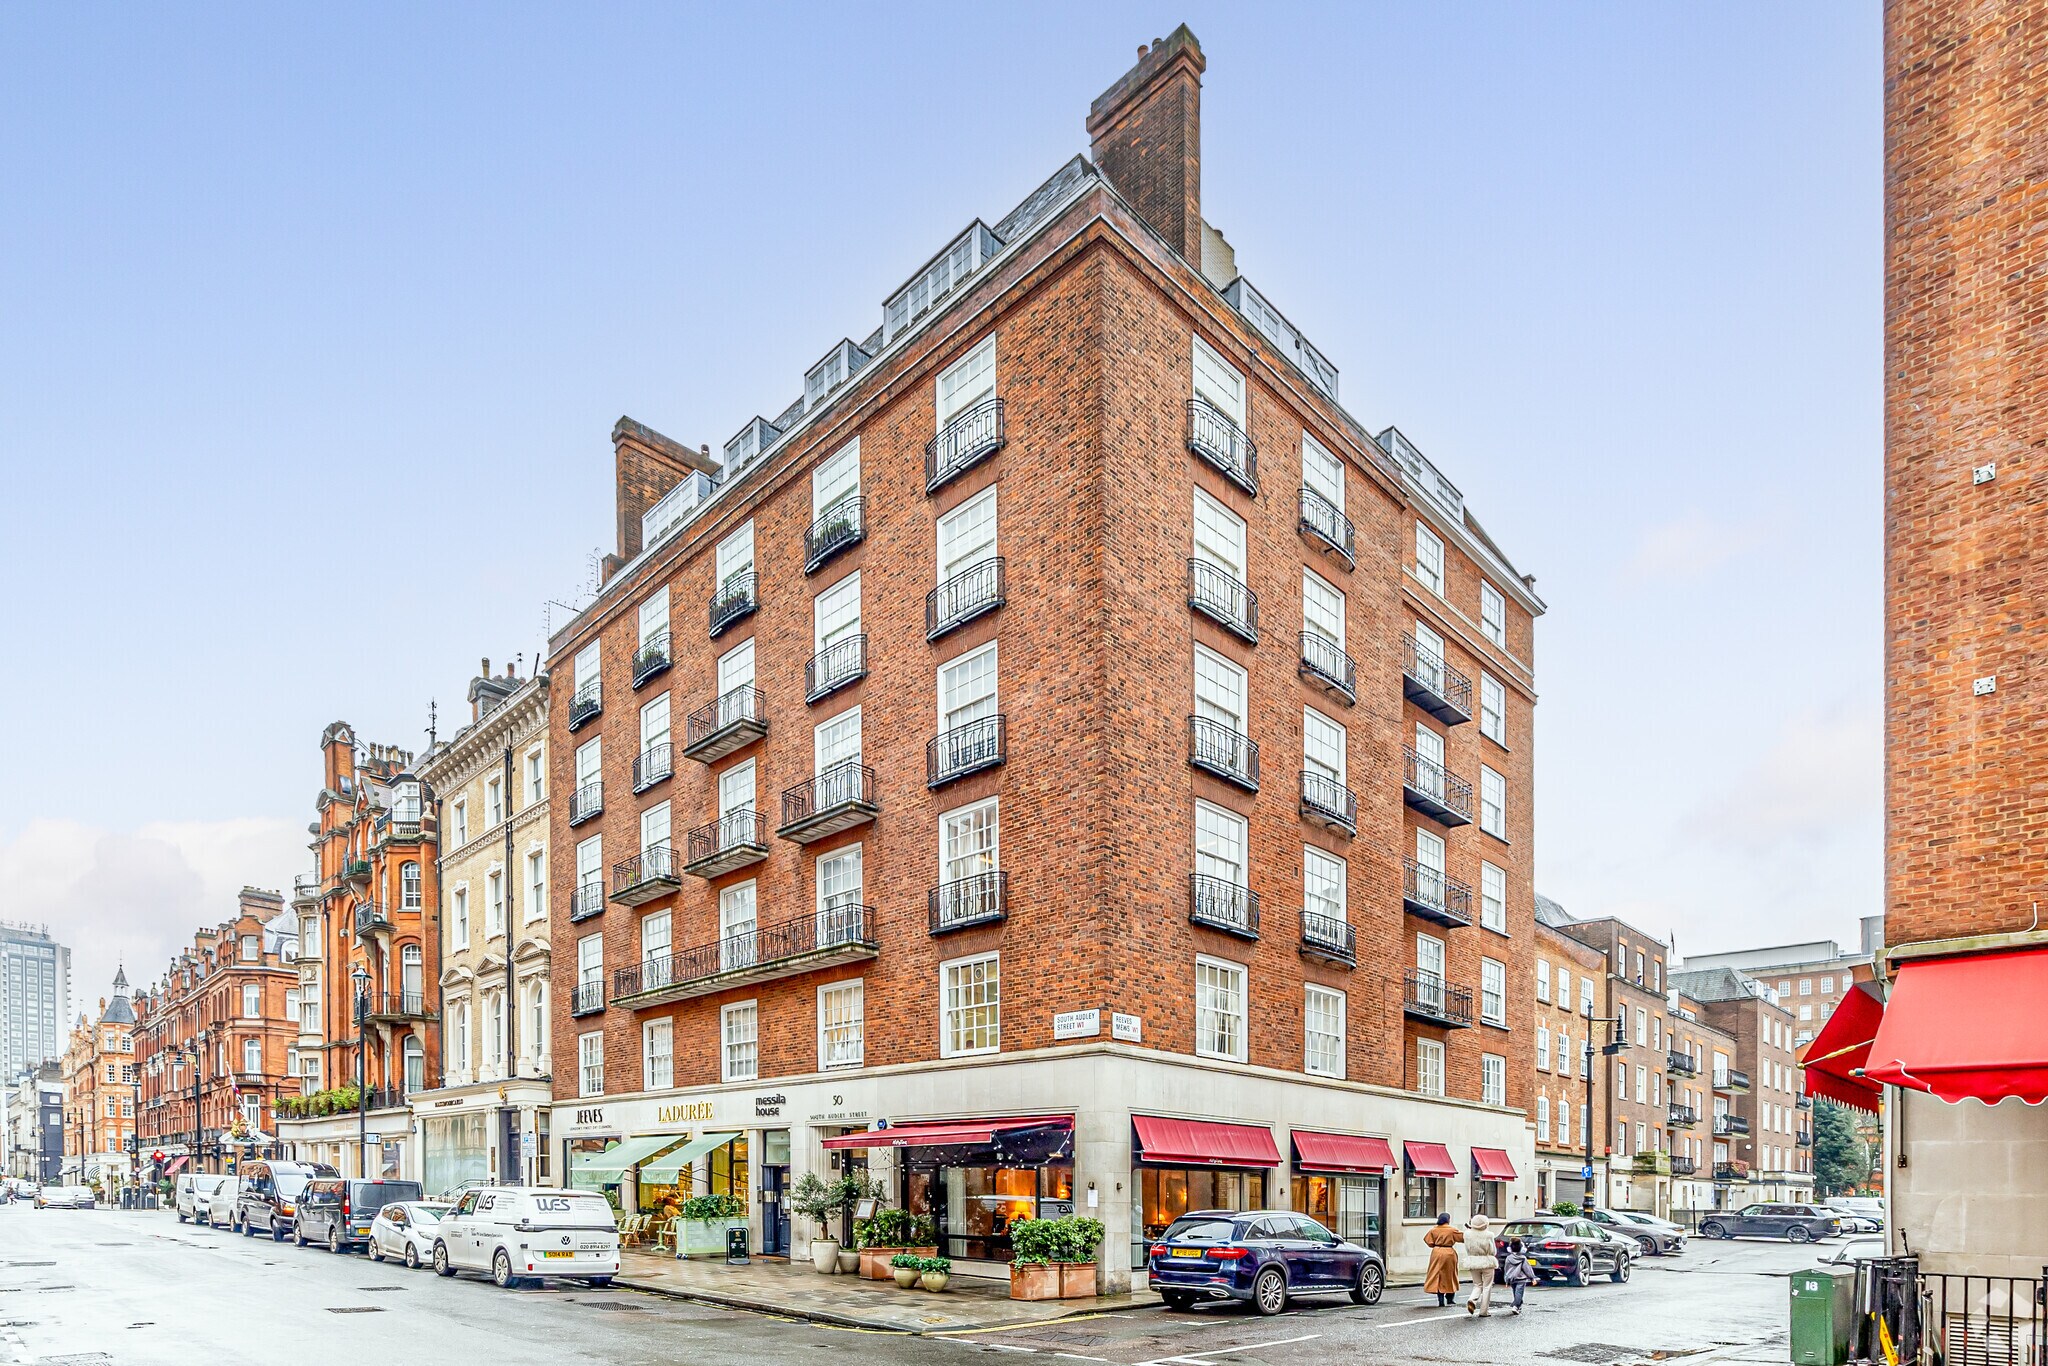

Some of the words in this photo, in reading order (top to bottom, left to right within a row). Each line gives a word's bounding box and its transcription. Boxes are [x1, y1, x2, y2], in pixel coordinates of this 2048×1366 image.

[1057, 1015, 1073, 1024] SOUTH
[1075, 1012, 1095, 1021] AUDLEY
[1115, 1016, 1132, 1024] REEVES
[1057, 1022, 1075, 1031] STREET
[1115, 1023, 1130, 1032] MEWS
[755, 1093, 786, 1106] messila
[832, 1095, 843, 1106] 50
[576, 1108, 603, 1124] JEEVES
[658, 1102, 714, 1122] LADURÉE
[755, 1106, 780, 1117] house
